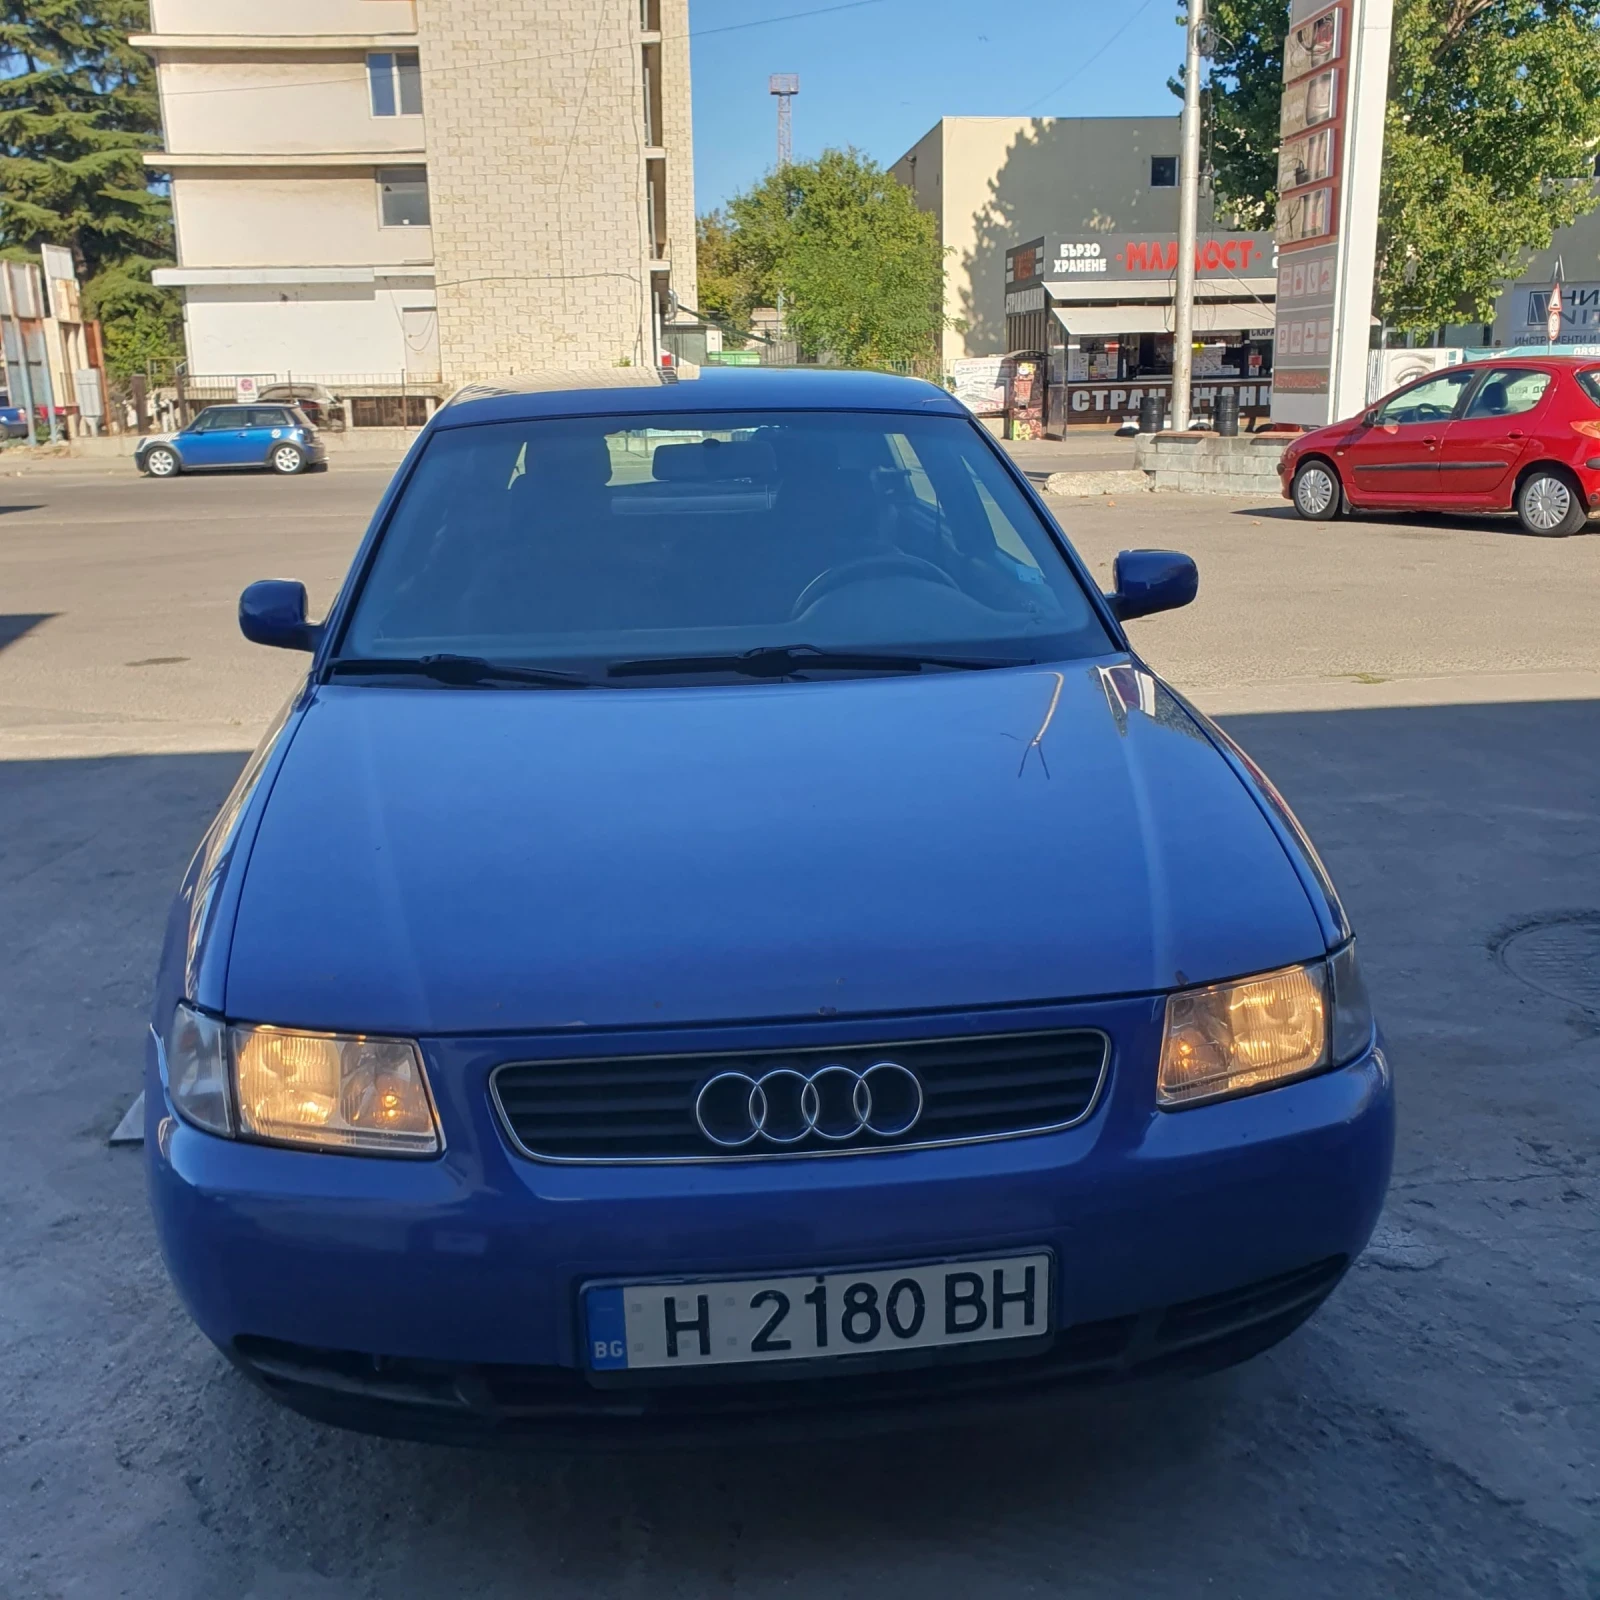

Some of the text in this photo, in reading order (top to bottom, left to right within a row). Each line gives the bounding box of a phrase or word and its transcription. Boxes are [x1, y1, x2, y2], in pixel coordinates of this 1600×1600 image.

[1060, 243, 1101, 258] БЪРЗО
[1126, 240, 1255, 272] МЛАОСТ
[1053, 258, 1107, 273] ХРАНЕНЕ
[1514, 335, 1587, 345] ИНСТРМЕНТИ
[664, 1265, 1036, 1358] H 2180 BH
[594, 1341, 624, 1360] BG
